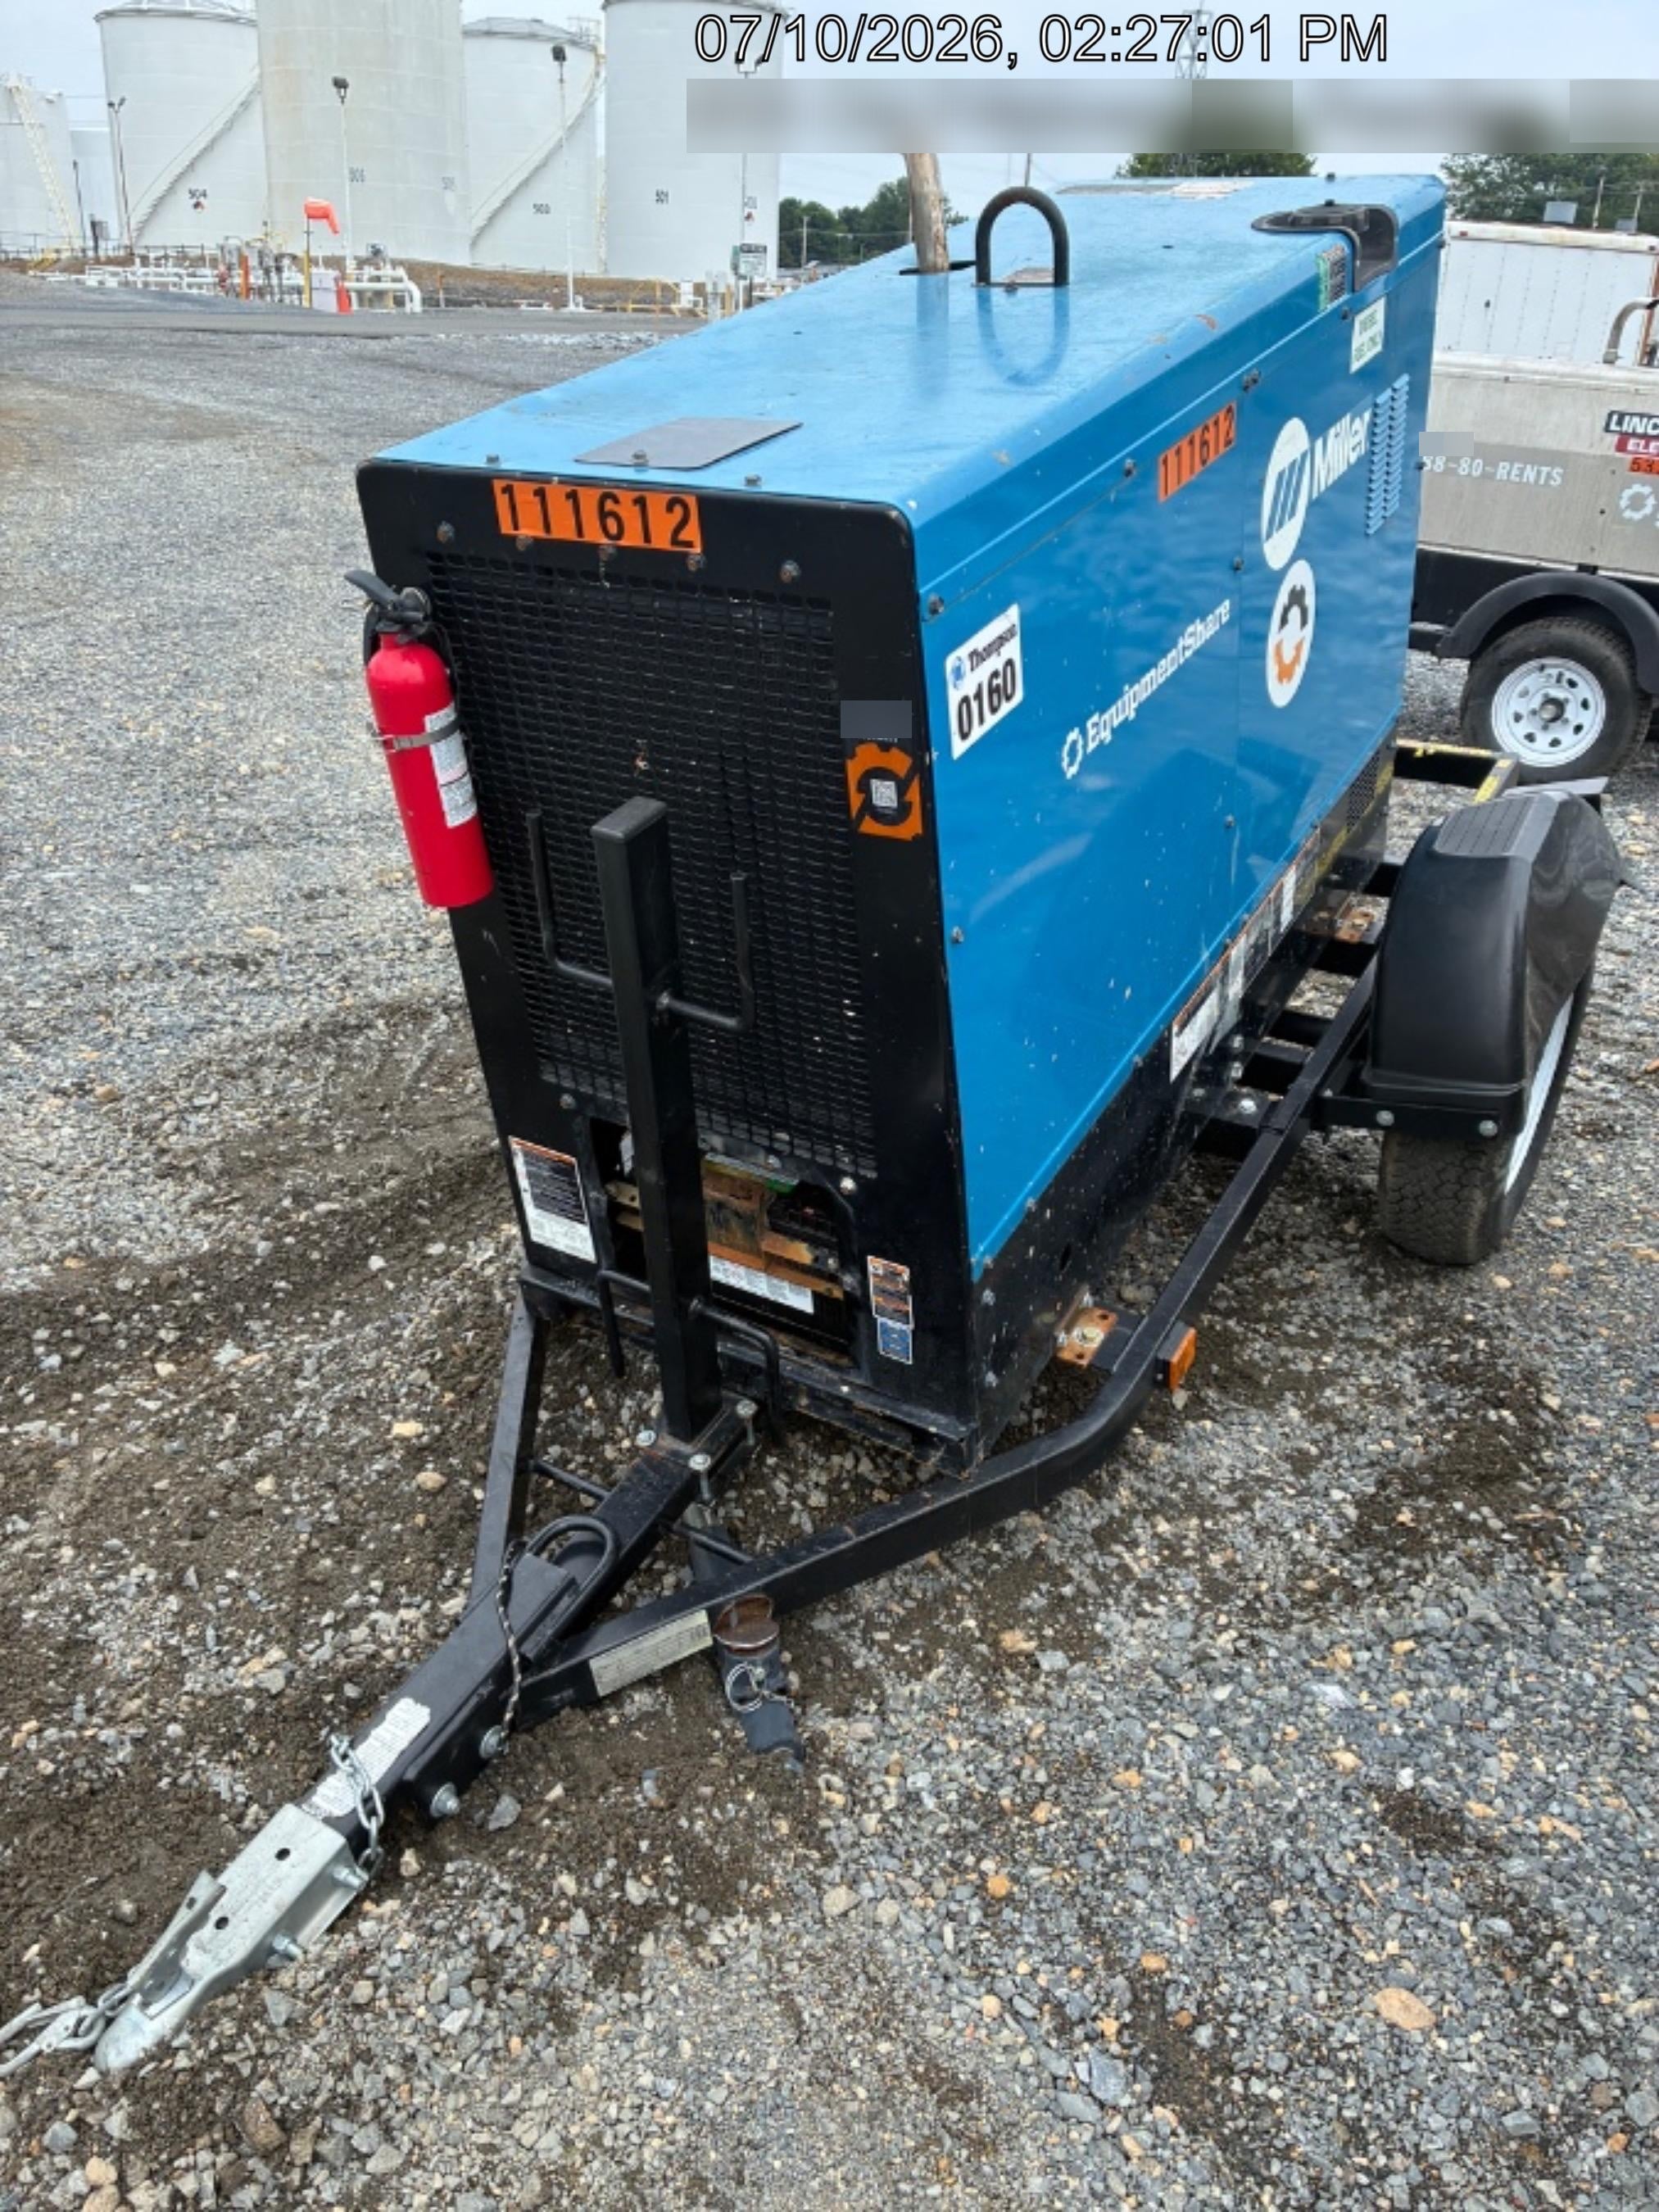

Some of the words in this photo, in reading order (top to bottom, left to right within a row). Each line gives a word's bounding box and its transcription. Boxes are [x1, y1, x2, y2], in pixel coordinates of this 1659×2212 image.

[1162, 404, 1235, 496] 111612
[1311, 408, 1371, 501] Miller
[501, 483, 694, 548] 111612
[968, 623, 1017, 672] Thompson
[1086, 599, 1231, 754] EquipmentShare
[958, 658, 1016, 741] 0160
